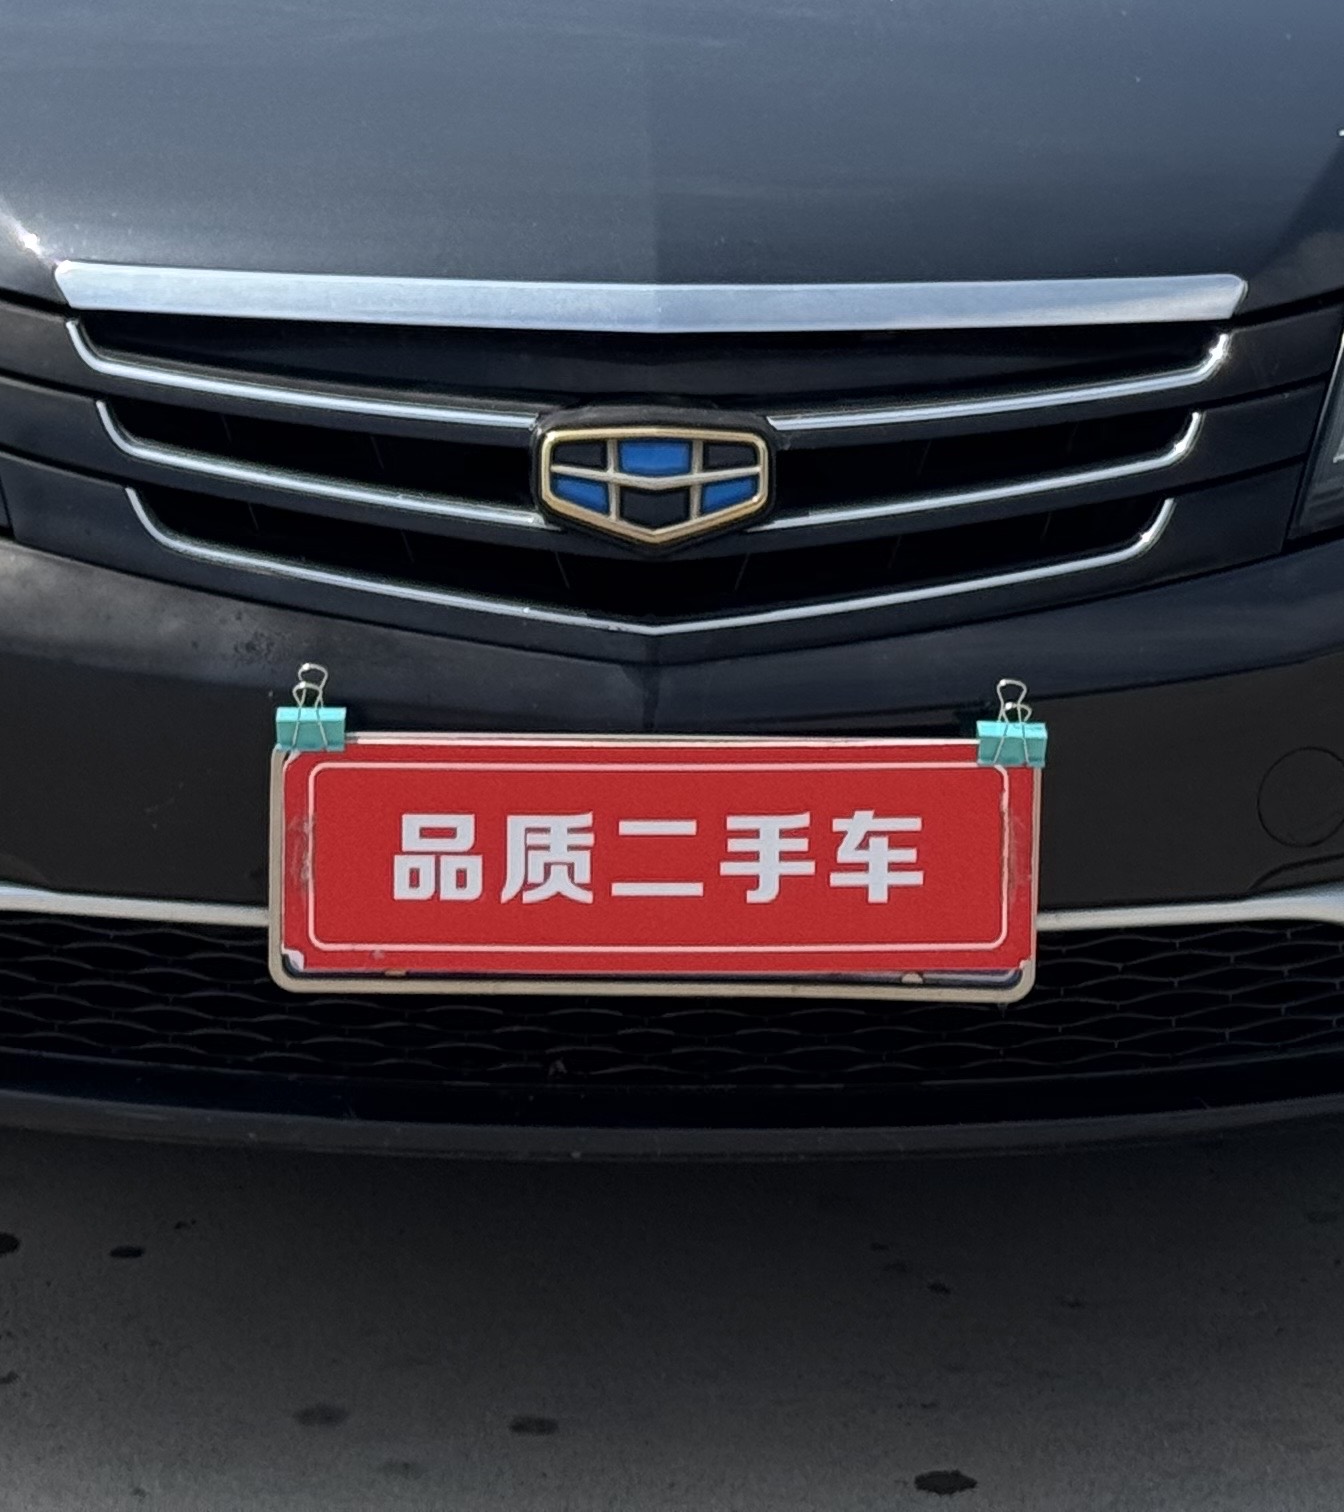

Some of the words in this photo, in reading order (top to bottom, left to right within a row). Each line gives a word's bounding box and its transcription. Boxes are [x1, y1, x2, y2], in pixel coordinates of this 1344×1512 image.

[393, 809, 925, 904] 品质二手车
